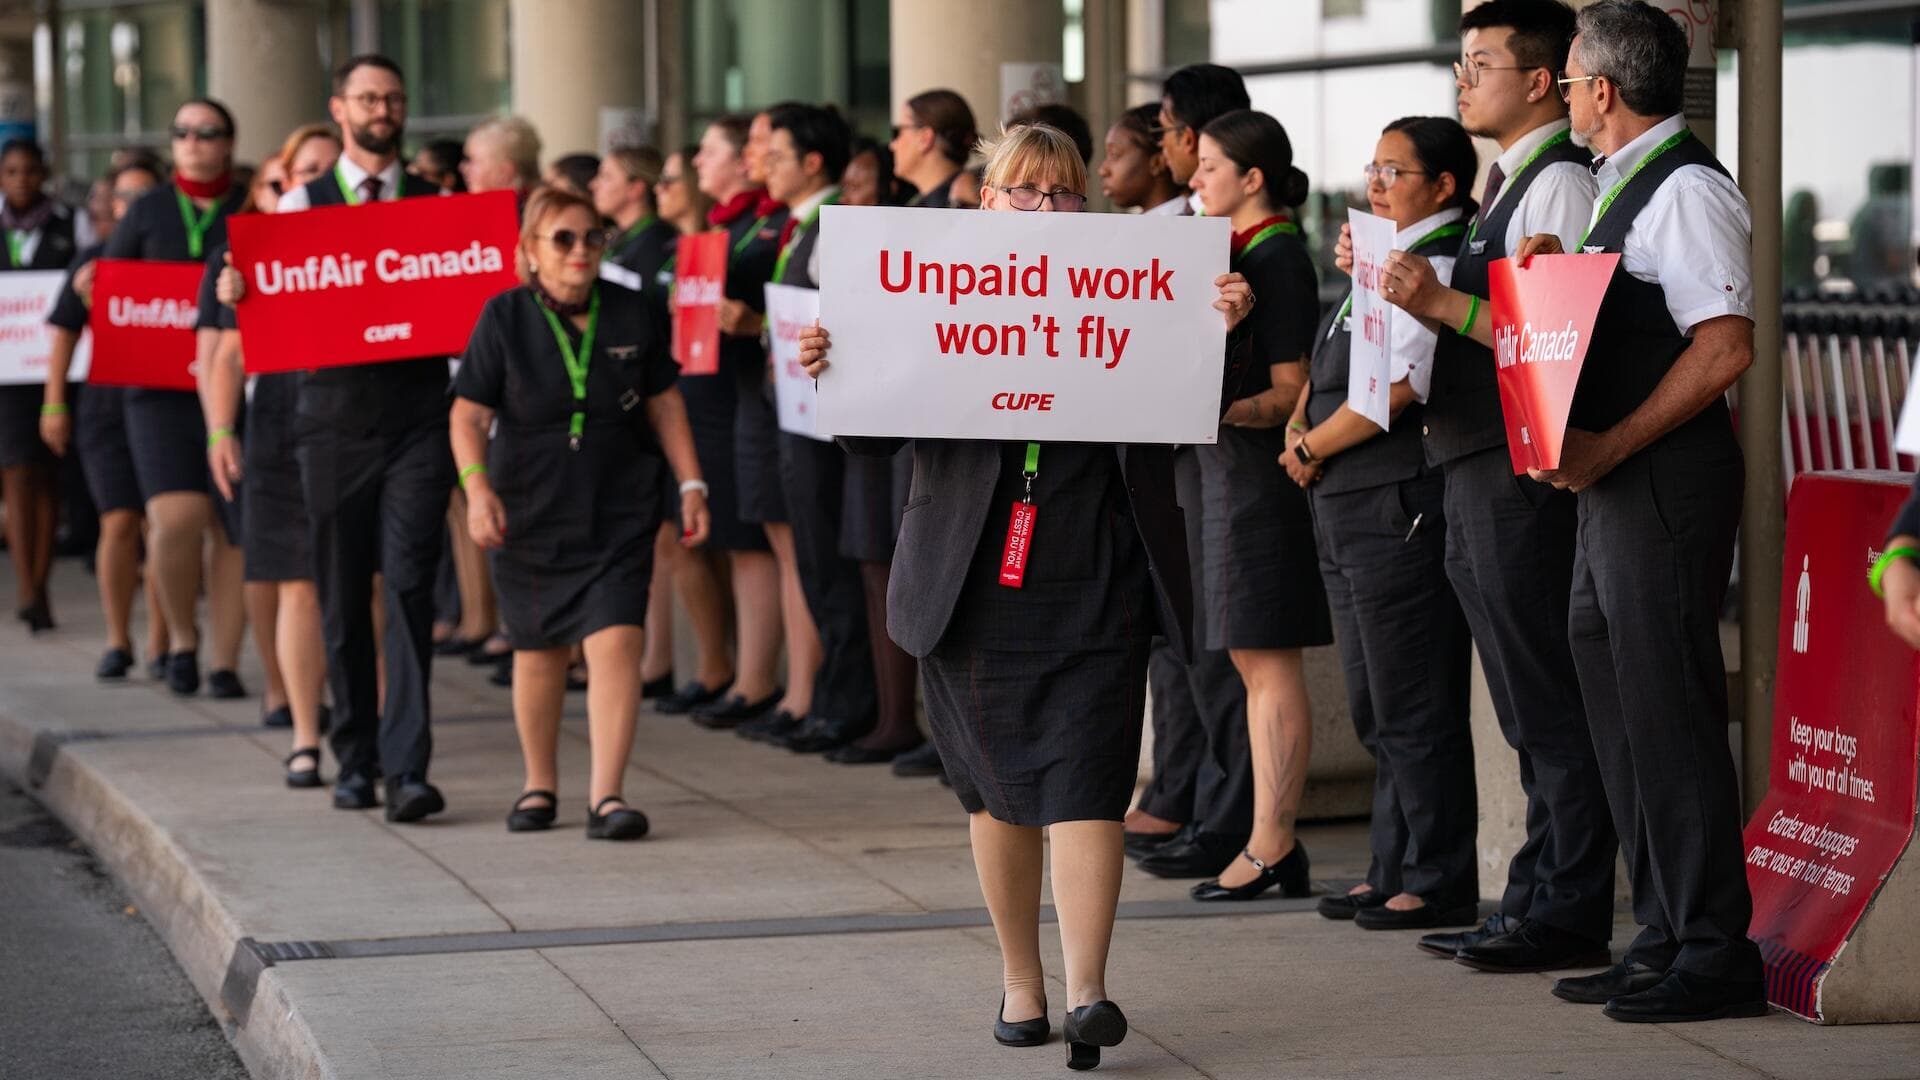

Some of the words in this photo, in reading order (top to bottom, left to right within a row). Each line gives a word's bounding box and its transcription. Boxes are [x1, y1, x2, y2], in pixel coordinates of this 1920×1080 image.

[254, 252, 367, 295] UnfAir
[374, 240, 503, 283] Canada
[880, 250, 1048, 305] Unpaid
[1067, 258, 1175, 301] work
[363, 322, 412, 343] CUPE
[935, 314, 1061, 358] won't
[1076, 315, 1131, 370] fly
[1520, 319, 1579, 364] Canada
[991, 392, 1055, 412] CUPE
[1006, 551, 1017, 567] VOL
[1010, 536, 1020, 550] DU
[1790, 716, 1812, 753] Keep
[1814, 727, 1835, 755] your
[1835, 725, 1857, 764] bags
[1788, 752, 1807, 783] with
[1808, 764, 1826, 792] you
[1825, 768, 1836, 792] at
[1836, 766, 1849, 796] all
[1849, 768, 1876, 803] times.
[1767, 809, 1802, 841] Gardez
[1799, 825, 1820, 844] vos
[1814, 822, 1860, 860] bagages
[1746, 845, 1773, 867] avec
[1769, 851, 1796, 875] vous
[1788, 857, 1807, 879] en
[1802, 860, 1828, 886] tout
[1823, 865, 1856, 899] temps.
